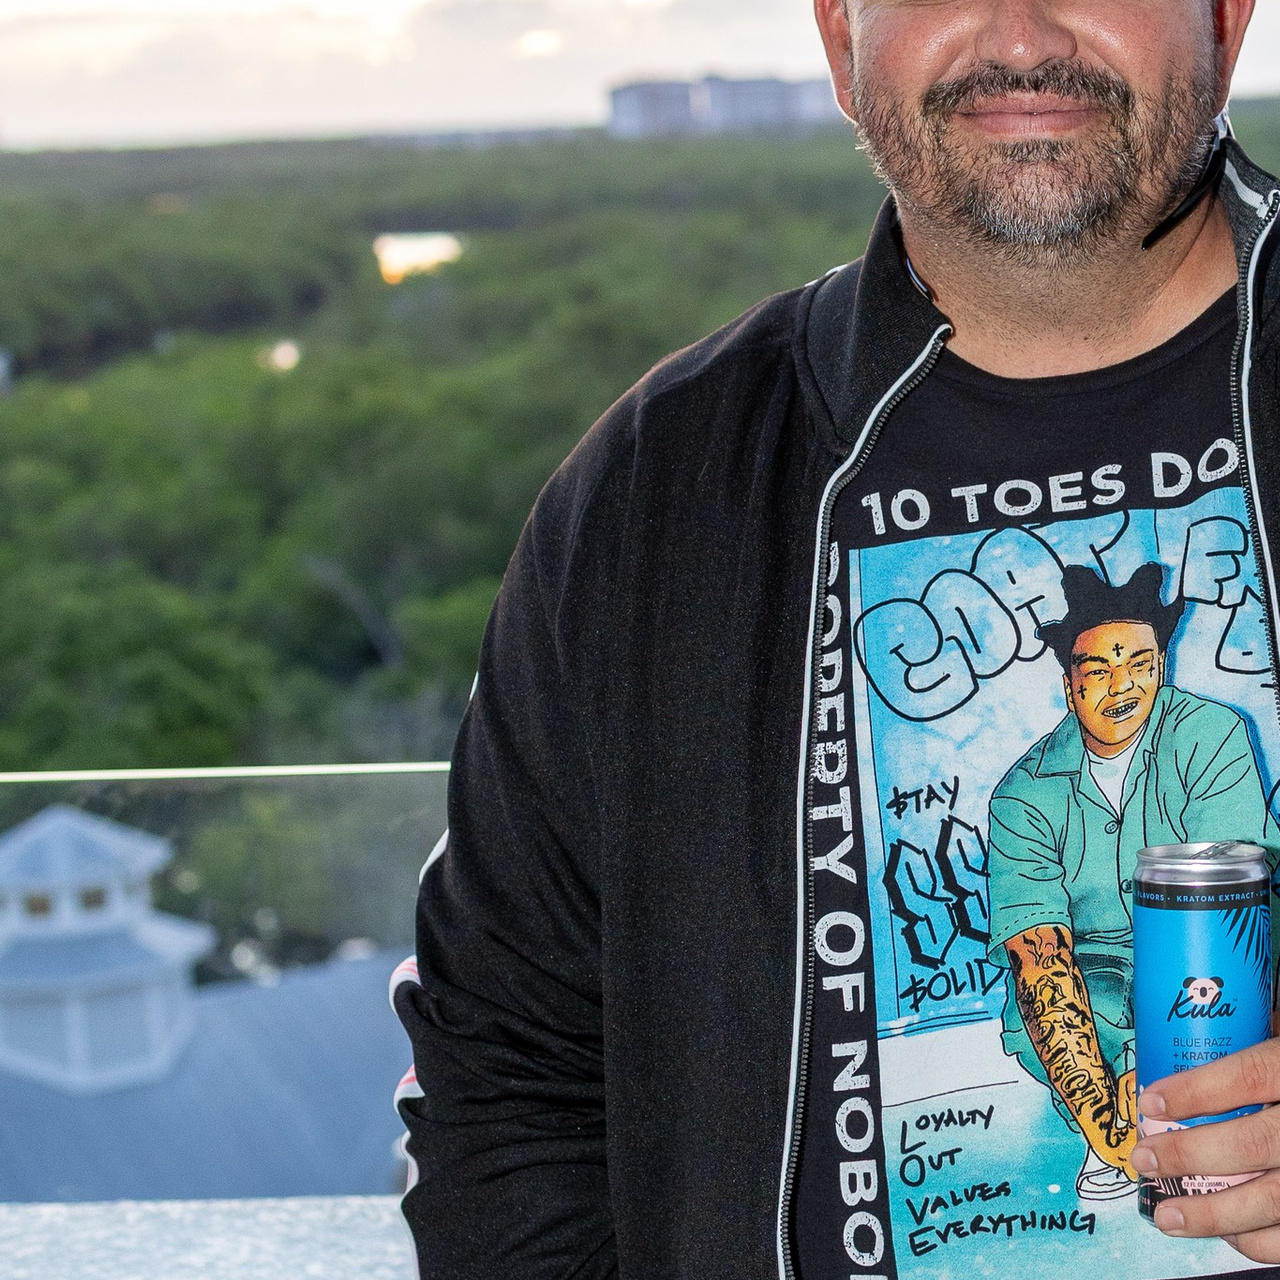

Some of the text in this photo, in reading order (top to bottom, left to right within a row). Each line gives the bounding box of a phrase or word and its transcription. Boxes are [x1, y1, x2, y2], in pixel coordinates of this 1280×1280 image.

[861, 488, 931, 536] 10
[951, 463, 1125, 524] TOES
[1176, 895, 1215, 903] KRATOM
[1218, 891, 1255, 902] EXTRACT
[814, 910, 866, 1014] OF
[1166, 989, 1237, 1023] Kula
[1173, 1036, 1233, 1048] BLUE RAZZ
[1181, 1050, 1229, 1061] KRATOM
[900, 1104, 995, 1155] LOYALTY
[899, 1147, 963, 1188] OUT
[908, 1209, 1096, 1257] EVERYTHING
